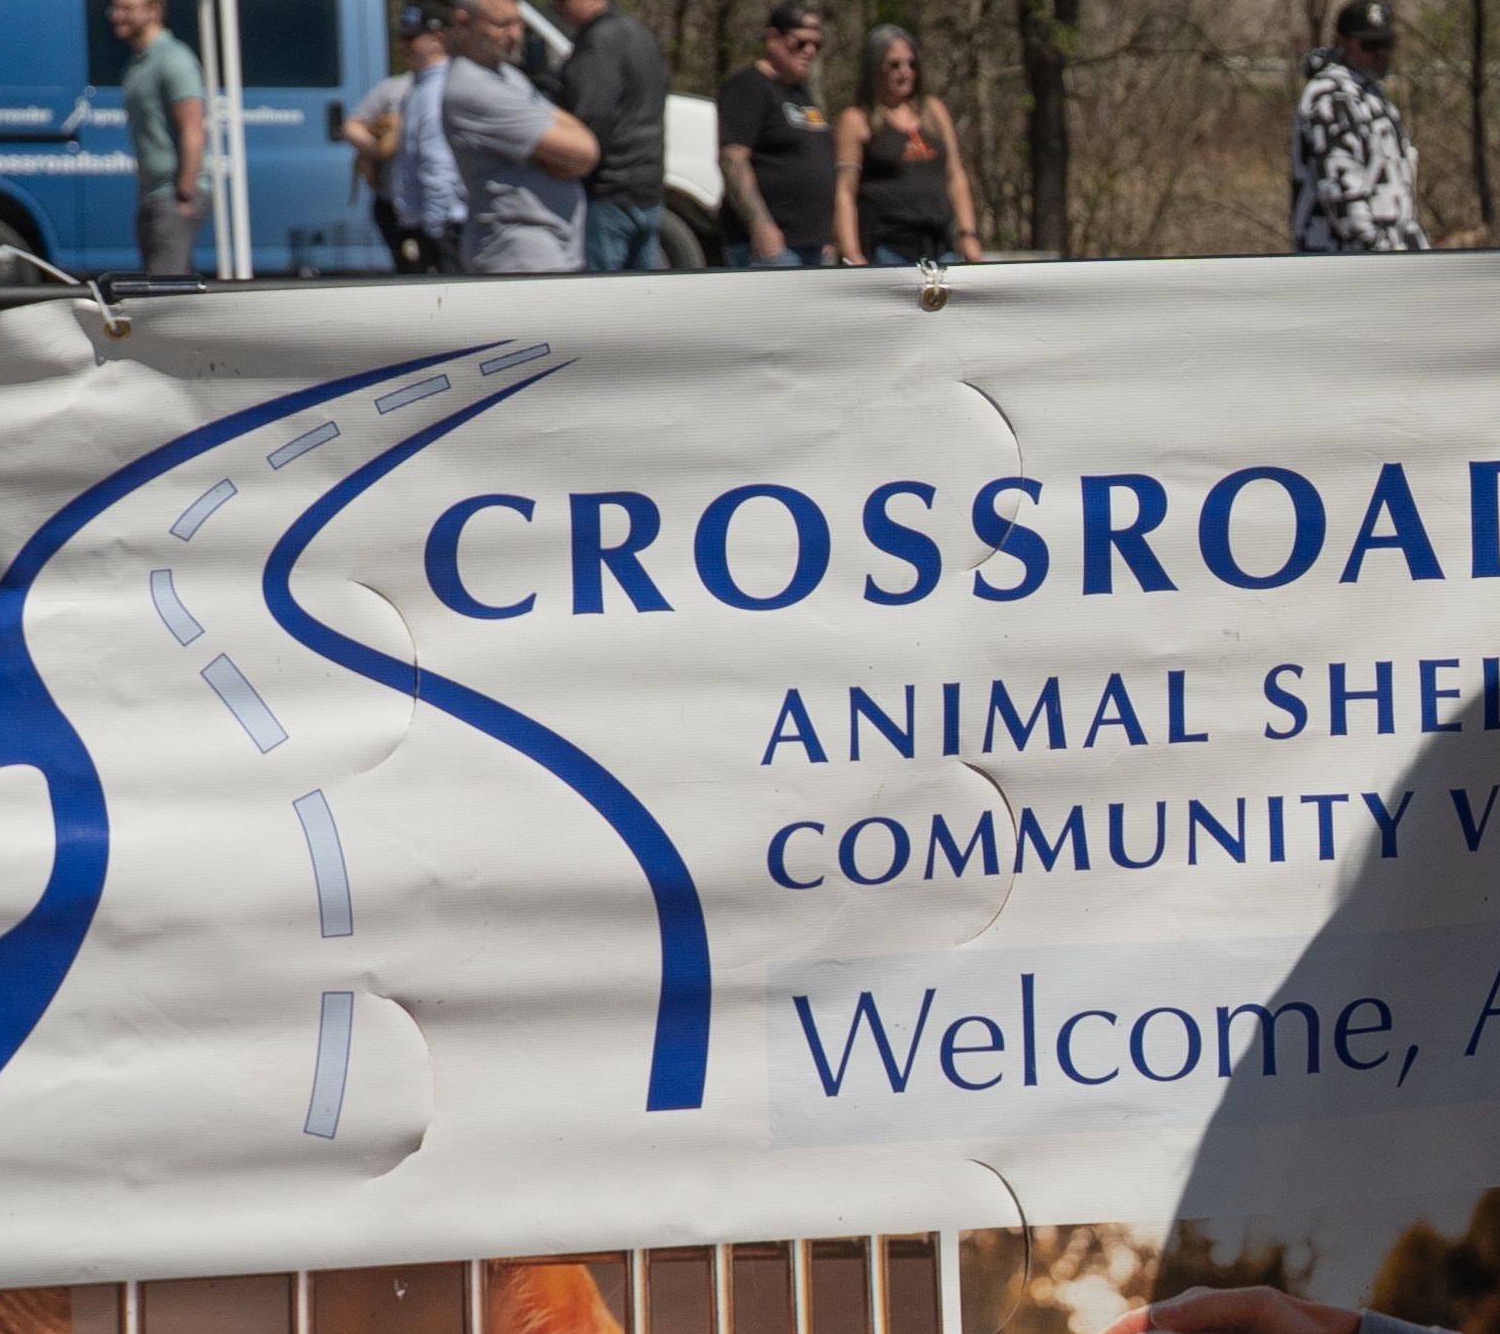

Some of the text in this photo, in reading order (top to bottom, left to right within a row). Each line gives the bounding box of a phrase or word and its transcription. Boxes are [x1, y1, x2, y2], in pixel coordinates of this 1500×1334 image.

[761, 671, 1209, 766] ANIMAL
[766, 790, 1416, 890] COMMUNITY
[792, 972, 1420, 1098] Welcome,
